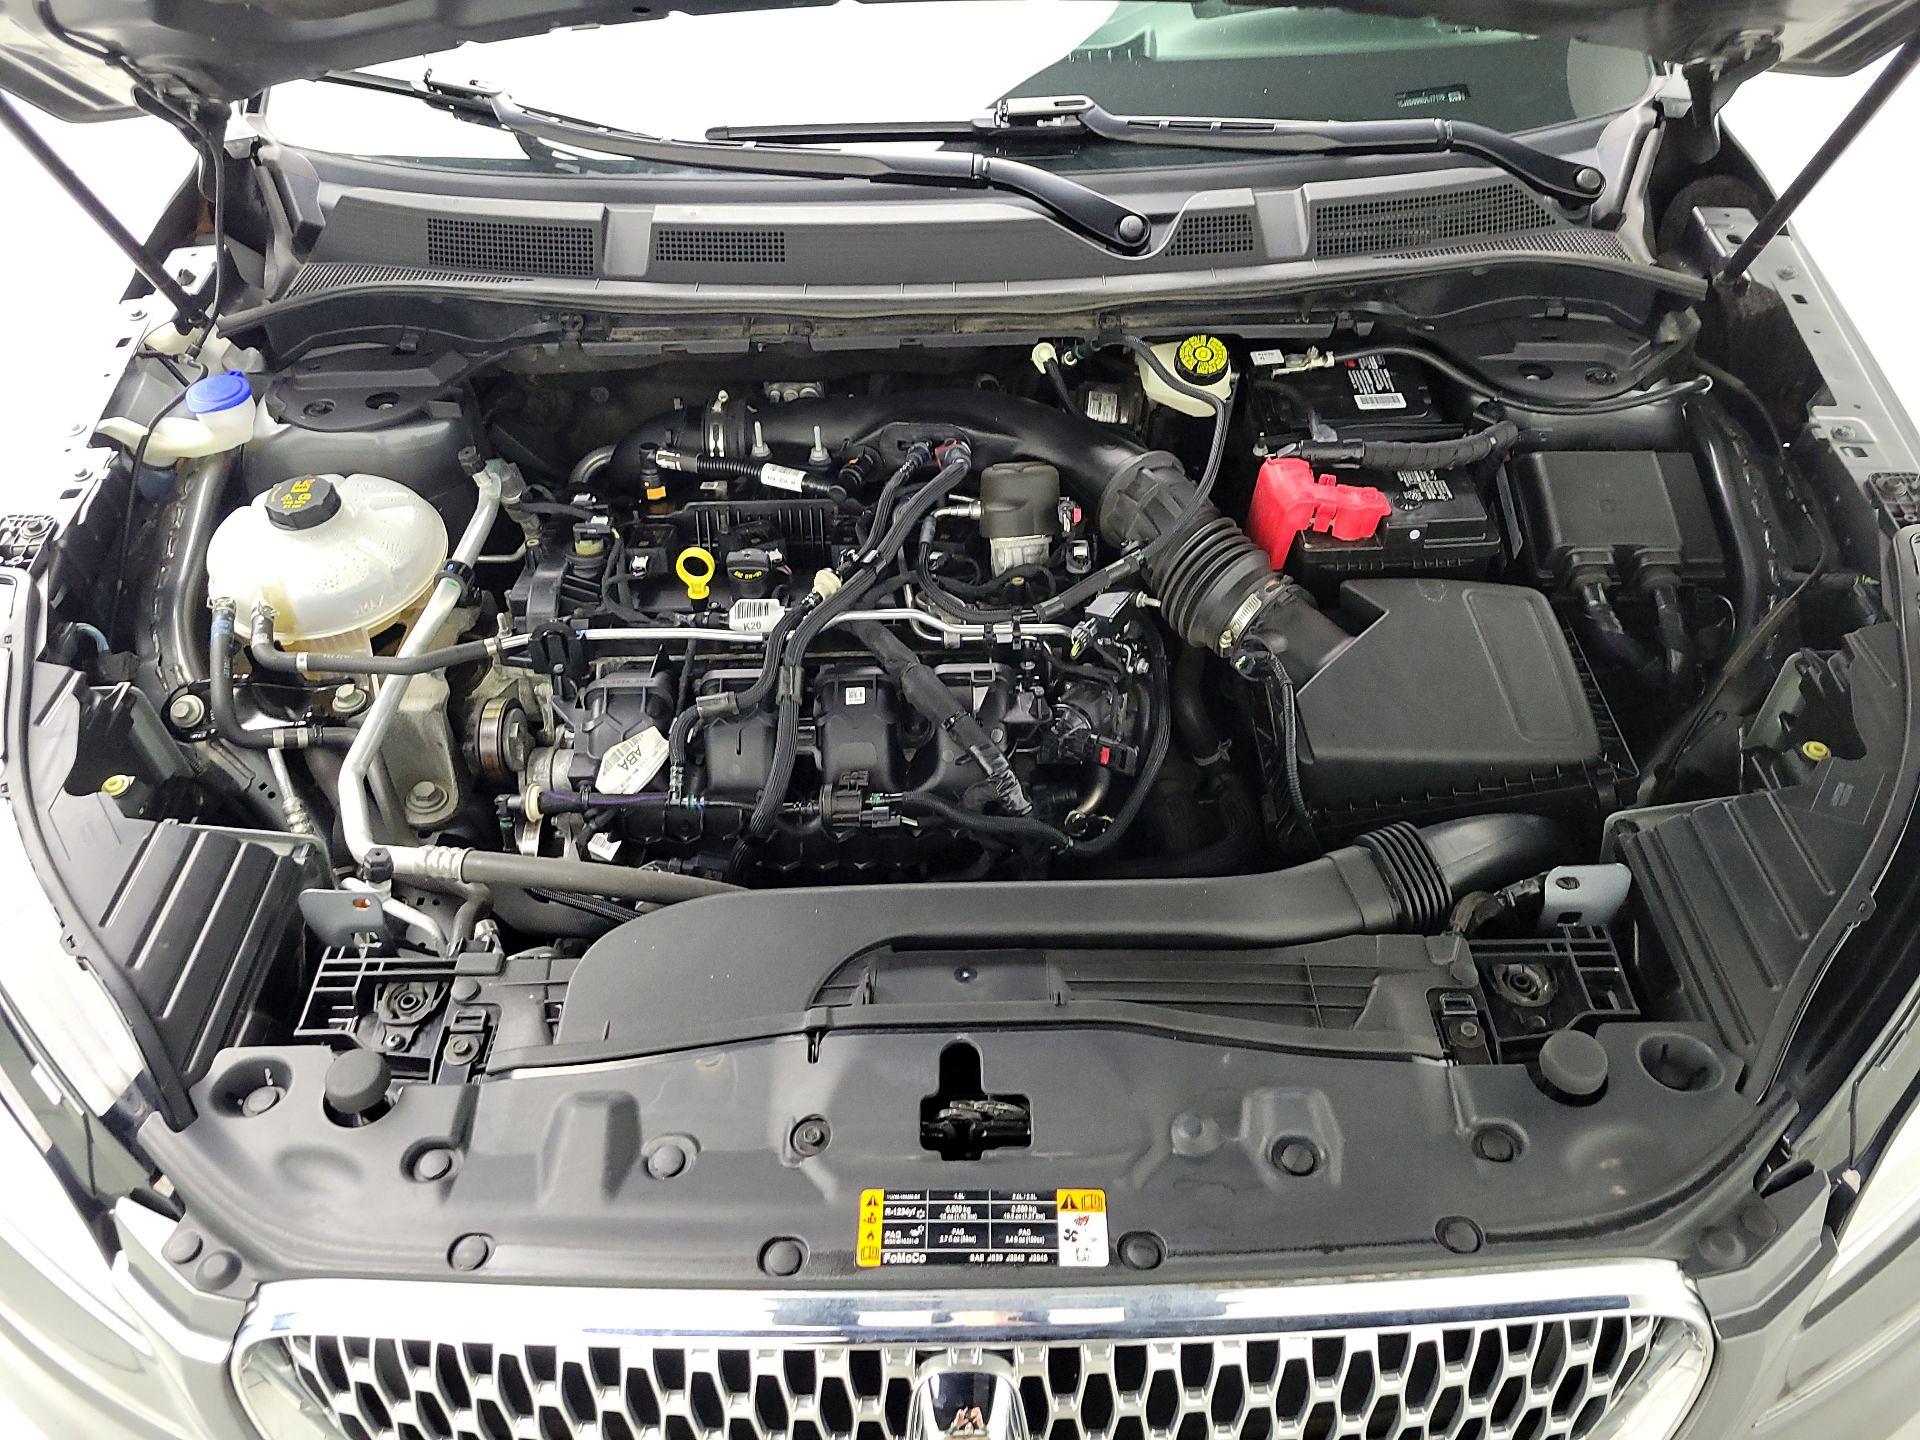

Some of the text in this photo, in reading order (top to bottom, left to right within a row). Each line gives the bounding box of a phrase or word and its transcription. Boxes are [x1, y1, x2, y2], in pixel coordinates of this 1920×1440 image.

[743, 622, 762, 631] K20
[618, 745, 642, 771] ABA
[884, 1206, 916, 1218] R-1234yf
[884, 1230, 902, 1239] PAG
[1018, 1228, 1031, 1236] PAG
[883, 1252, 927, 1264] FoMoCo
